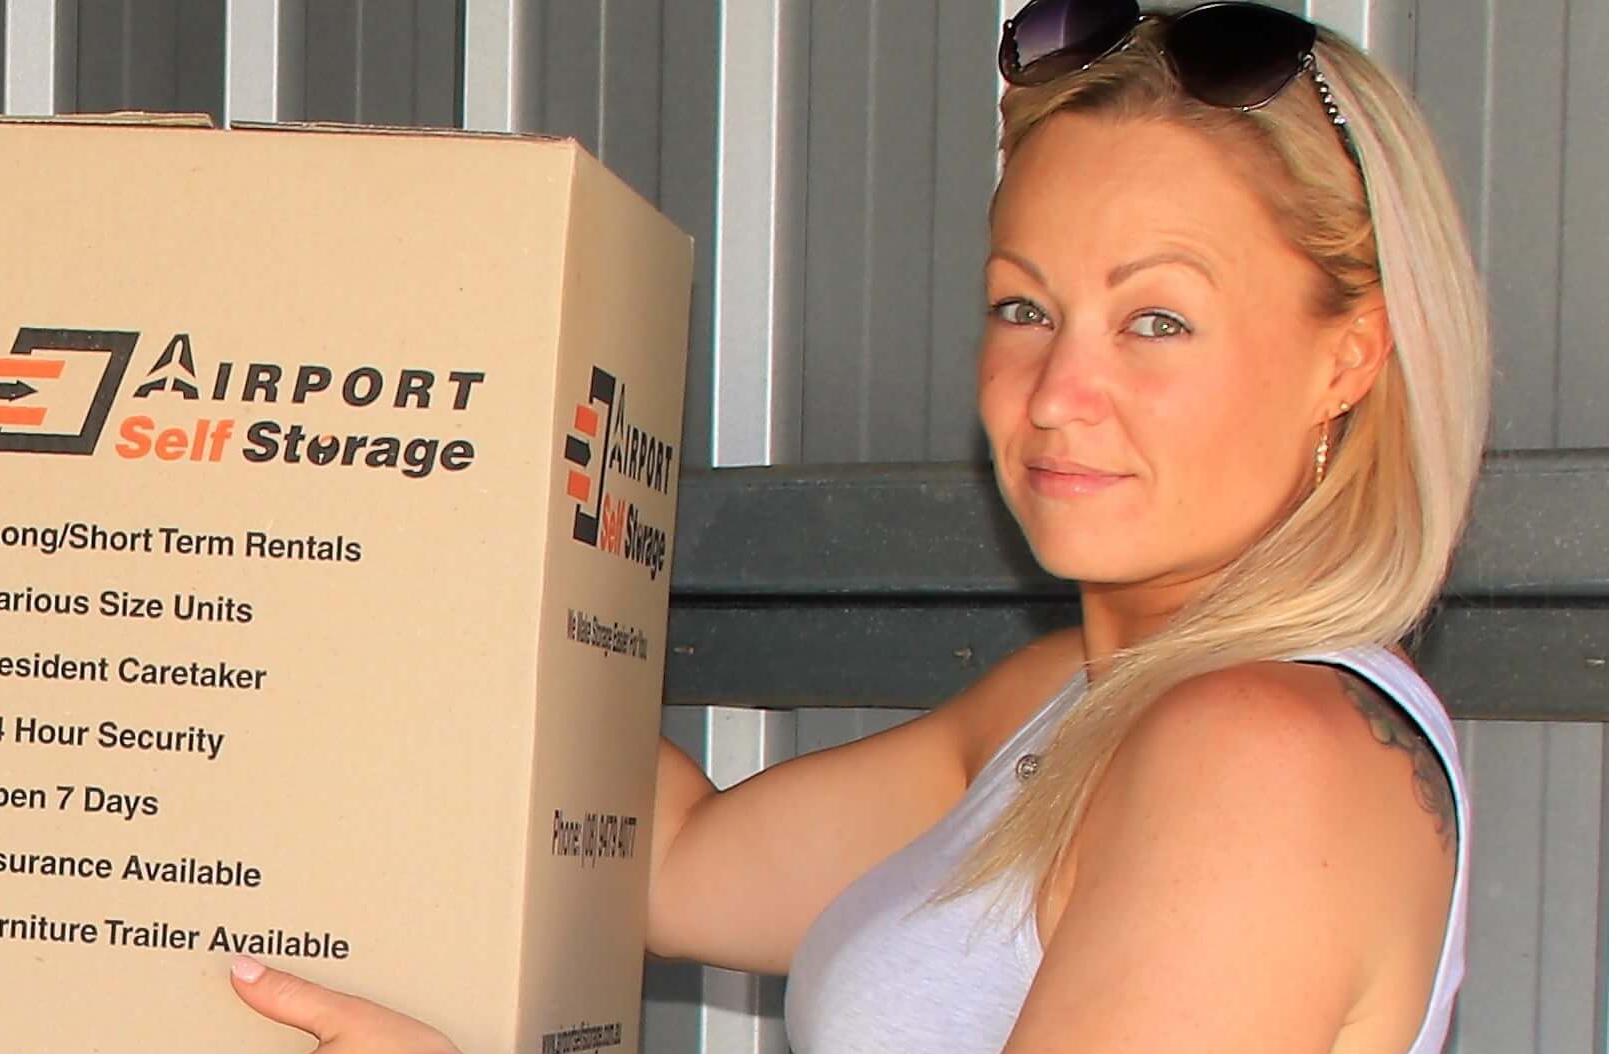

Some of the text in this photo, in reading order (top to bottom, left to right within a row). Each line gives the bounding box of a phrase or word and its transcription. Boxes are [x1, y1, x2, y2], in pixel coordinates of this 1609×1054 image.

[133, 334, 486, 411] AIRPORT
[115, 415, 476, 479] Self Storage
[609, 384, 674, 495] AIRPORT
[159, 527, 235, 557] Term
[245, 531, 362, 562] Rentals
[598, 492, 667, 581] Self Storage
[99, 590, 164, 619] Size
[174, 594, 253, 624] Units
[118, 657, 267, 690] Caretaker
[15, 716, 90, 746] Hour
[98, 721, 225, 761] Security
[56, 785, 75, 811] 7
[84, 786, 159, 821] Days
[121, 855, 262, 888] Available
[104, 919, 200, 950] Trailer
[208, 926, 349, 960] Available
